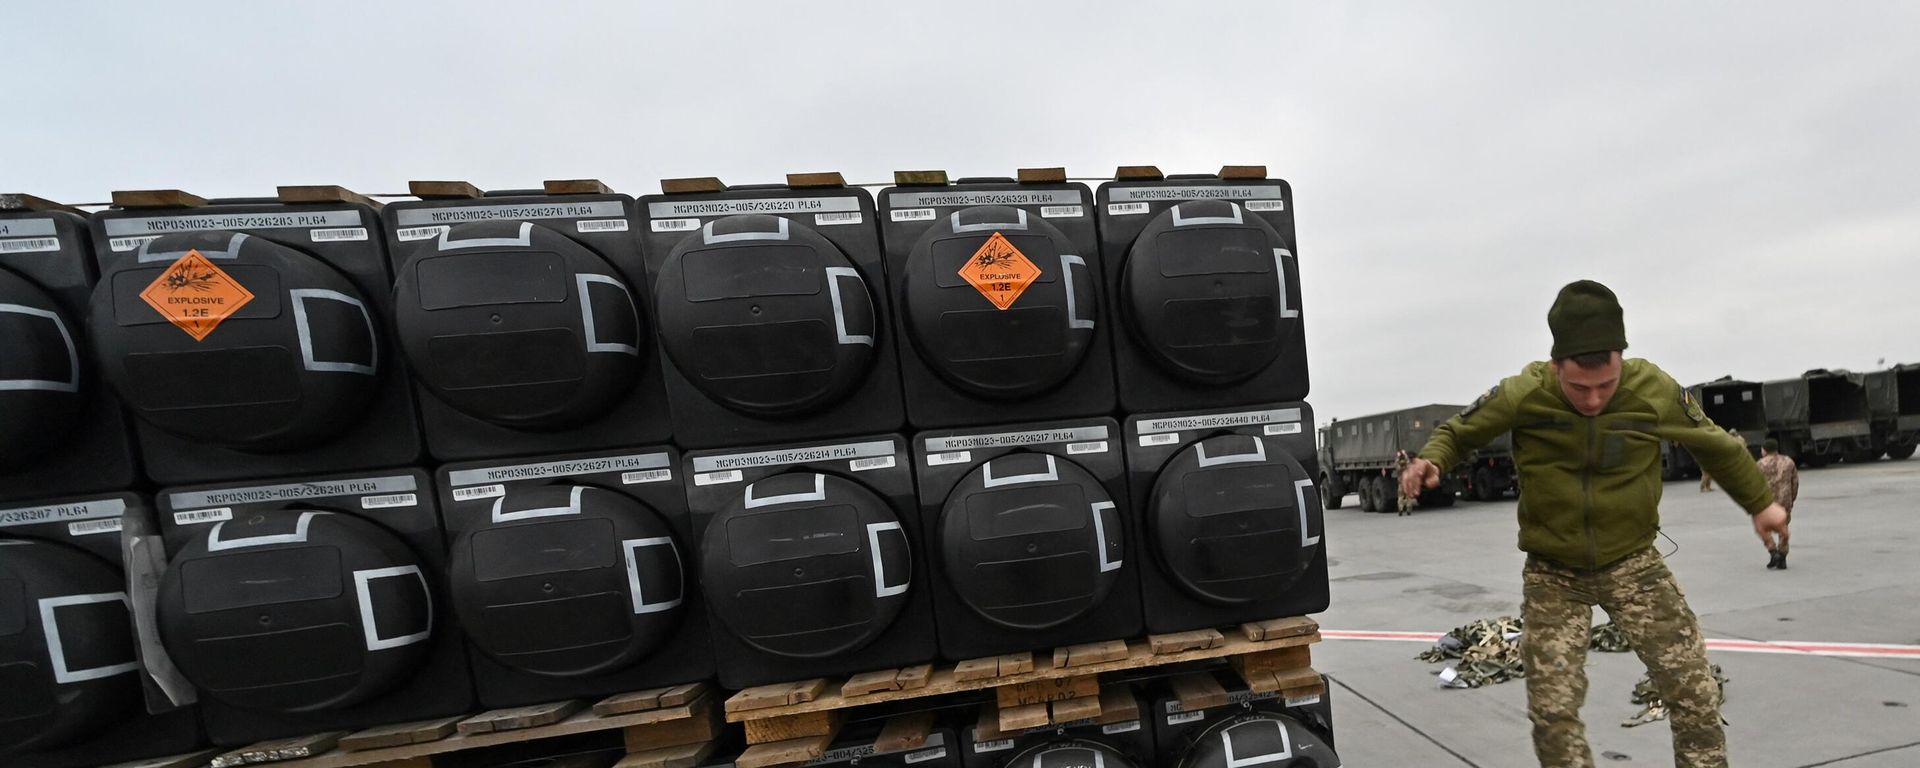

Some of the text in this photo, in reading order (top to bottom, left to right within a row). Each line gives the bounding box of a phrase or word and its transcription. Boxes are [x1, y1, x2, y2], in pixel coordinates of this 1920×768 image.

[1031, 193, 1053, 203] PL64
[1233, 188, 1253, 198] PL64
[798, 199, 822, 210] PL64
[567, 204, 593, 217] PL64
[298, 214, 328, 226] PL64
[979, 273, 1021, 281] EXPLOSIVE
[992, 282, 1012, 292] 1.2E
[167, 296, 225, 305] EXPLOSIVE
[182, 307, 209, 318] 1.2E
[1252, 414, 1270, 424] PL64
[1053, 431, 1074, 442] PL64
[833, 446, 857, 459] PL64
[615, 457, 640, 470] PL64
[349, 481, 378, 494] PL64
[57, 505, 89, 517] PL64
